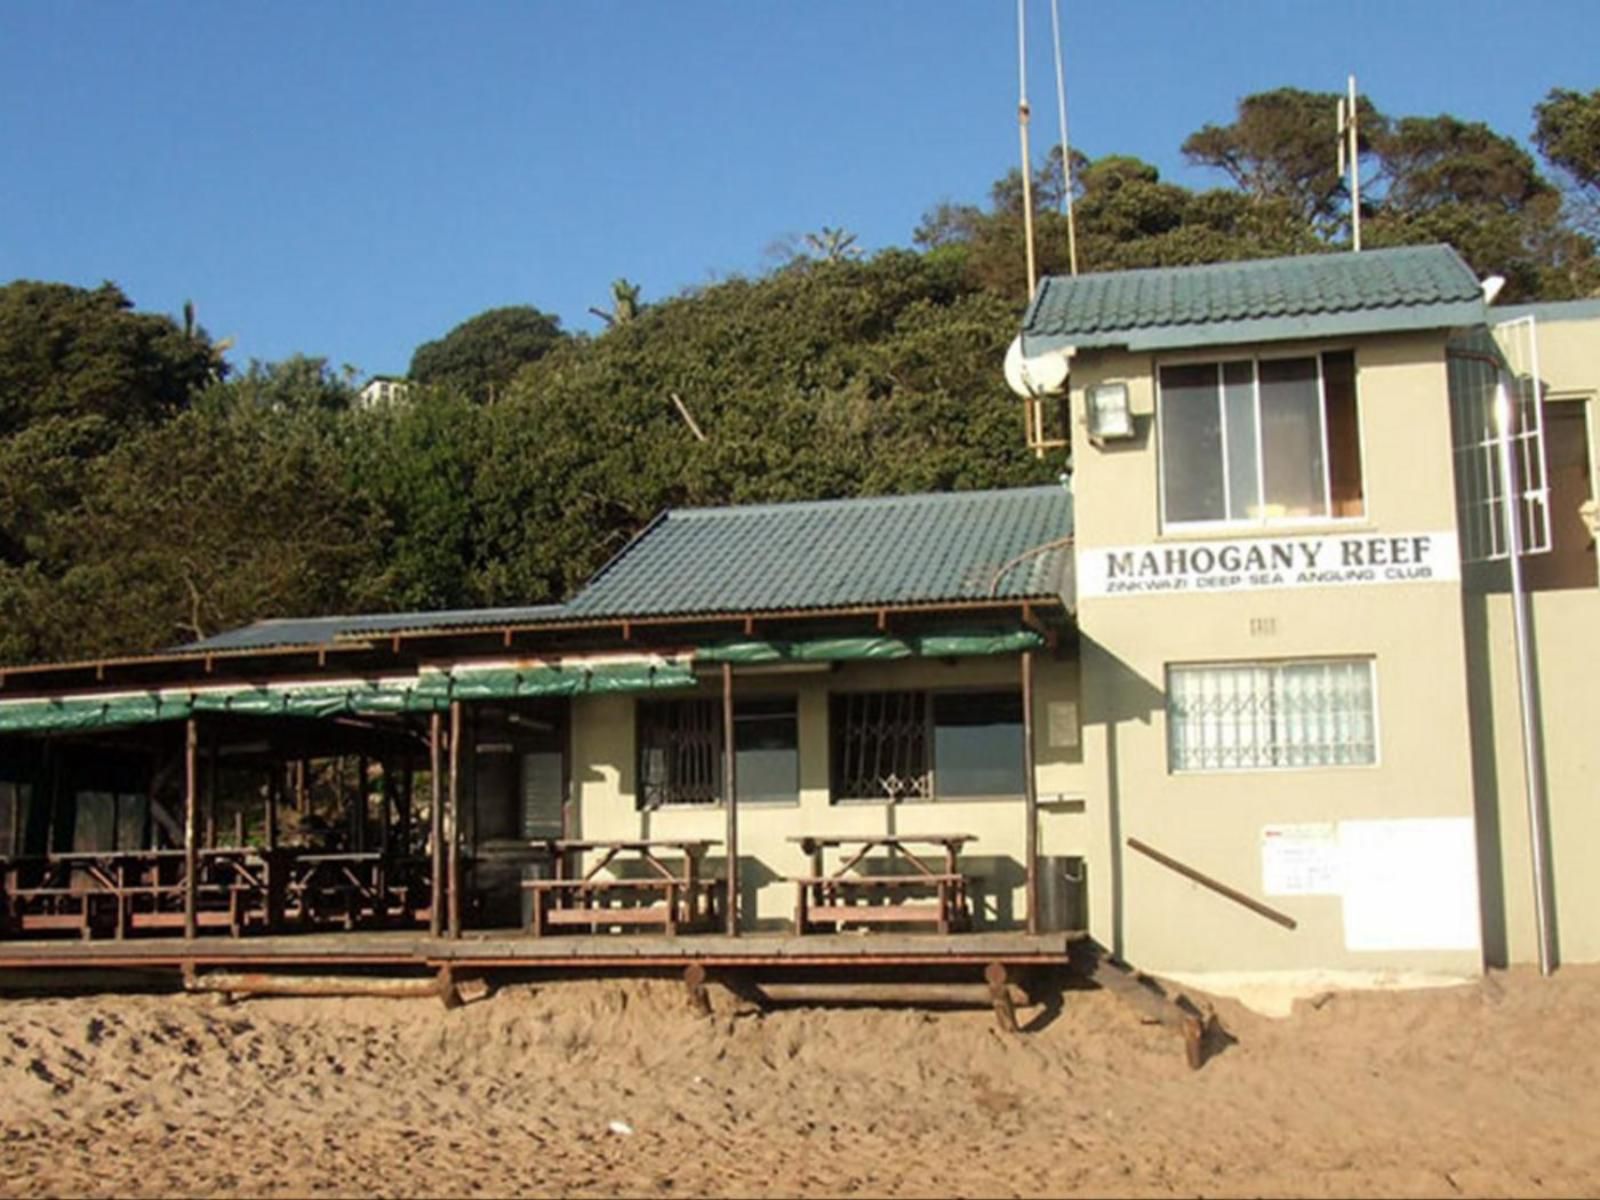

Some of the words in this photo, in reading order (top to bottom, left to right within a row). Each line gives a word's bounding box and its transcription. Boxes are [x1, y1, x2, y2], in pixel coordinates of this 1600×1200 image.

[1106, 541, 1323, 579] MAHOGANY
[1340, 536, 1432, 567] REEF
[1105, 578, 1188, 593] ZINKWAZI
[1196, 574, 1242, 588] DEEP
[1249, 572, 1284, 585] SEA
[1296, 569, 1375, 583] ANGLING
[1385, 566, 1433, 580] CLUB
